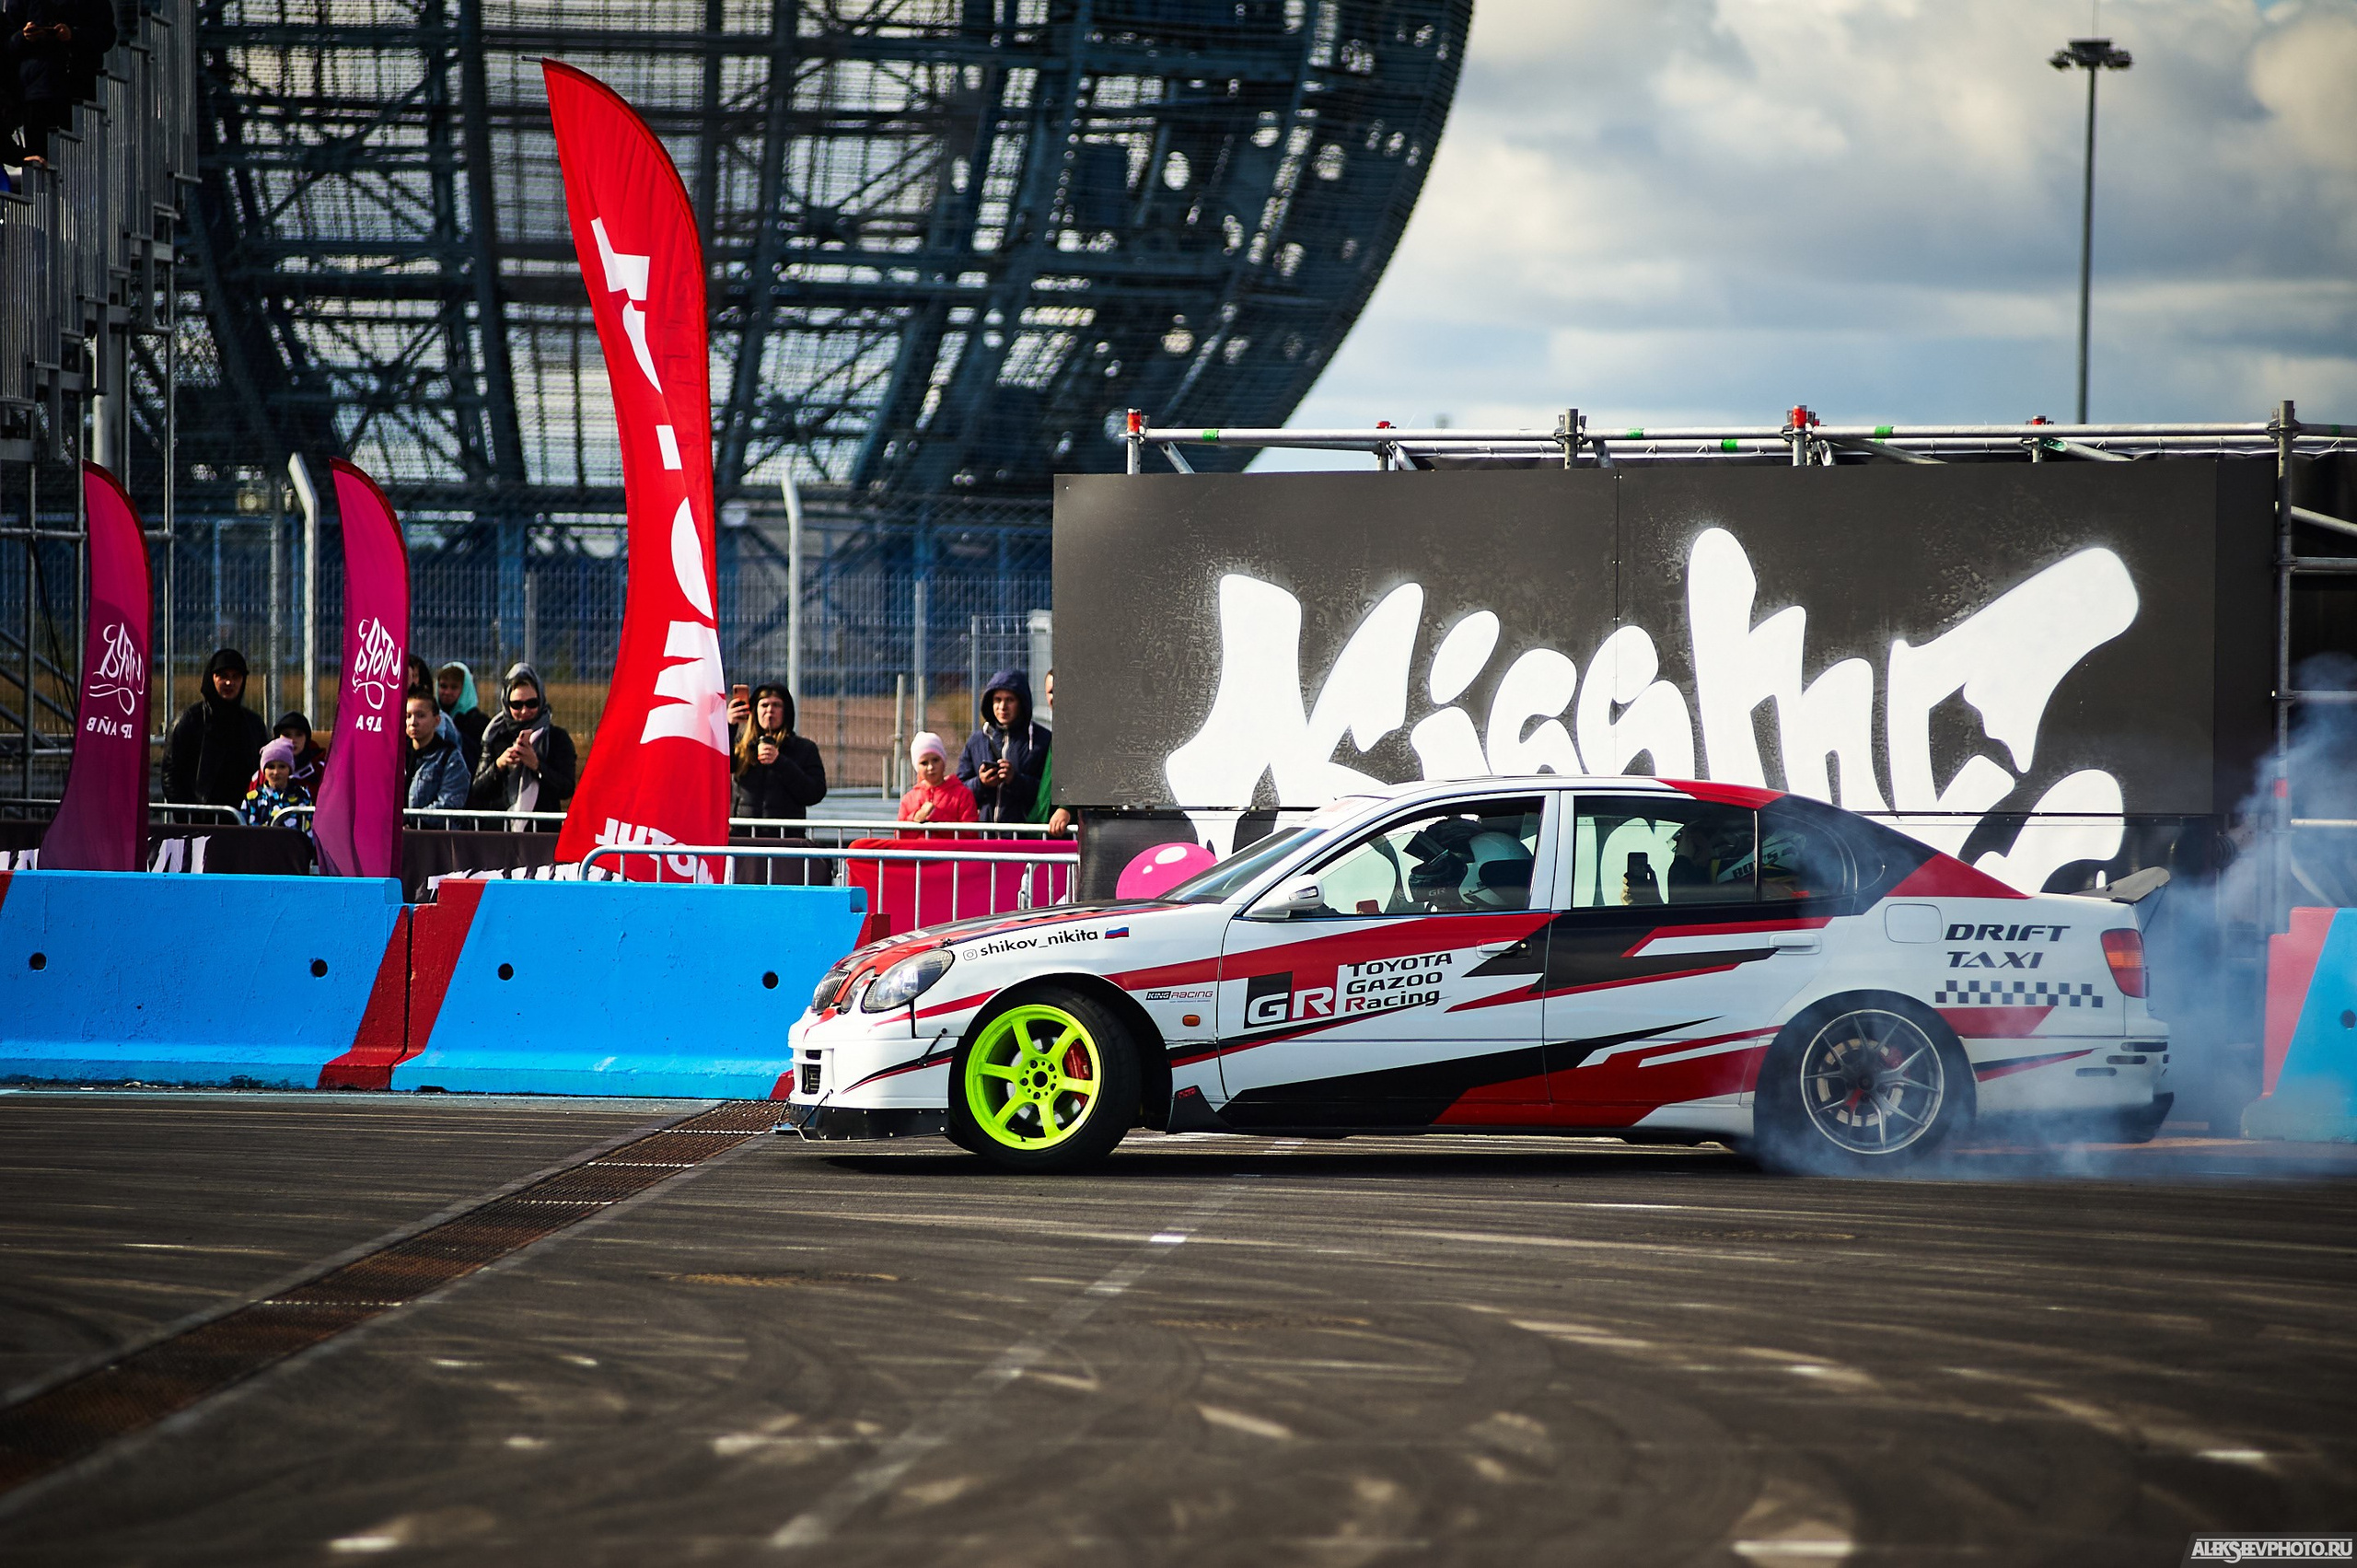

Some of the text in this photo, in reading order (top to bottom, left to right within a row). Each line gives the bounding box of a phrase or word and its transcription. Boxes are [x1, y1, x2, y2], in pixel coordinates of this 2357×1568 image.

[980, 928, 1098, 957] shikov_nikita
[1945, 923, 2071, 942] DRIFT
[1347, 953, 1452, 977] TOYOTA
[1947, 951, 2044, 969] TAXI
[1346, 971, 1443, 994] GAZOO
[1248, 986, 1334, 1025] GR
[1344, 990, 1441, 1013] Racing
